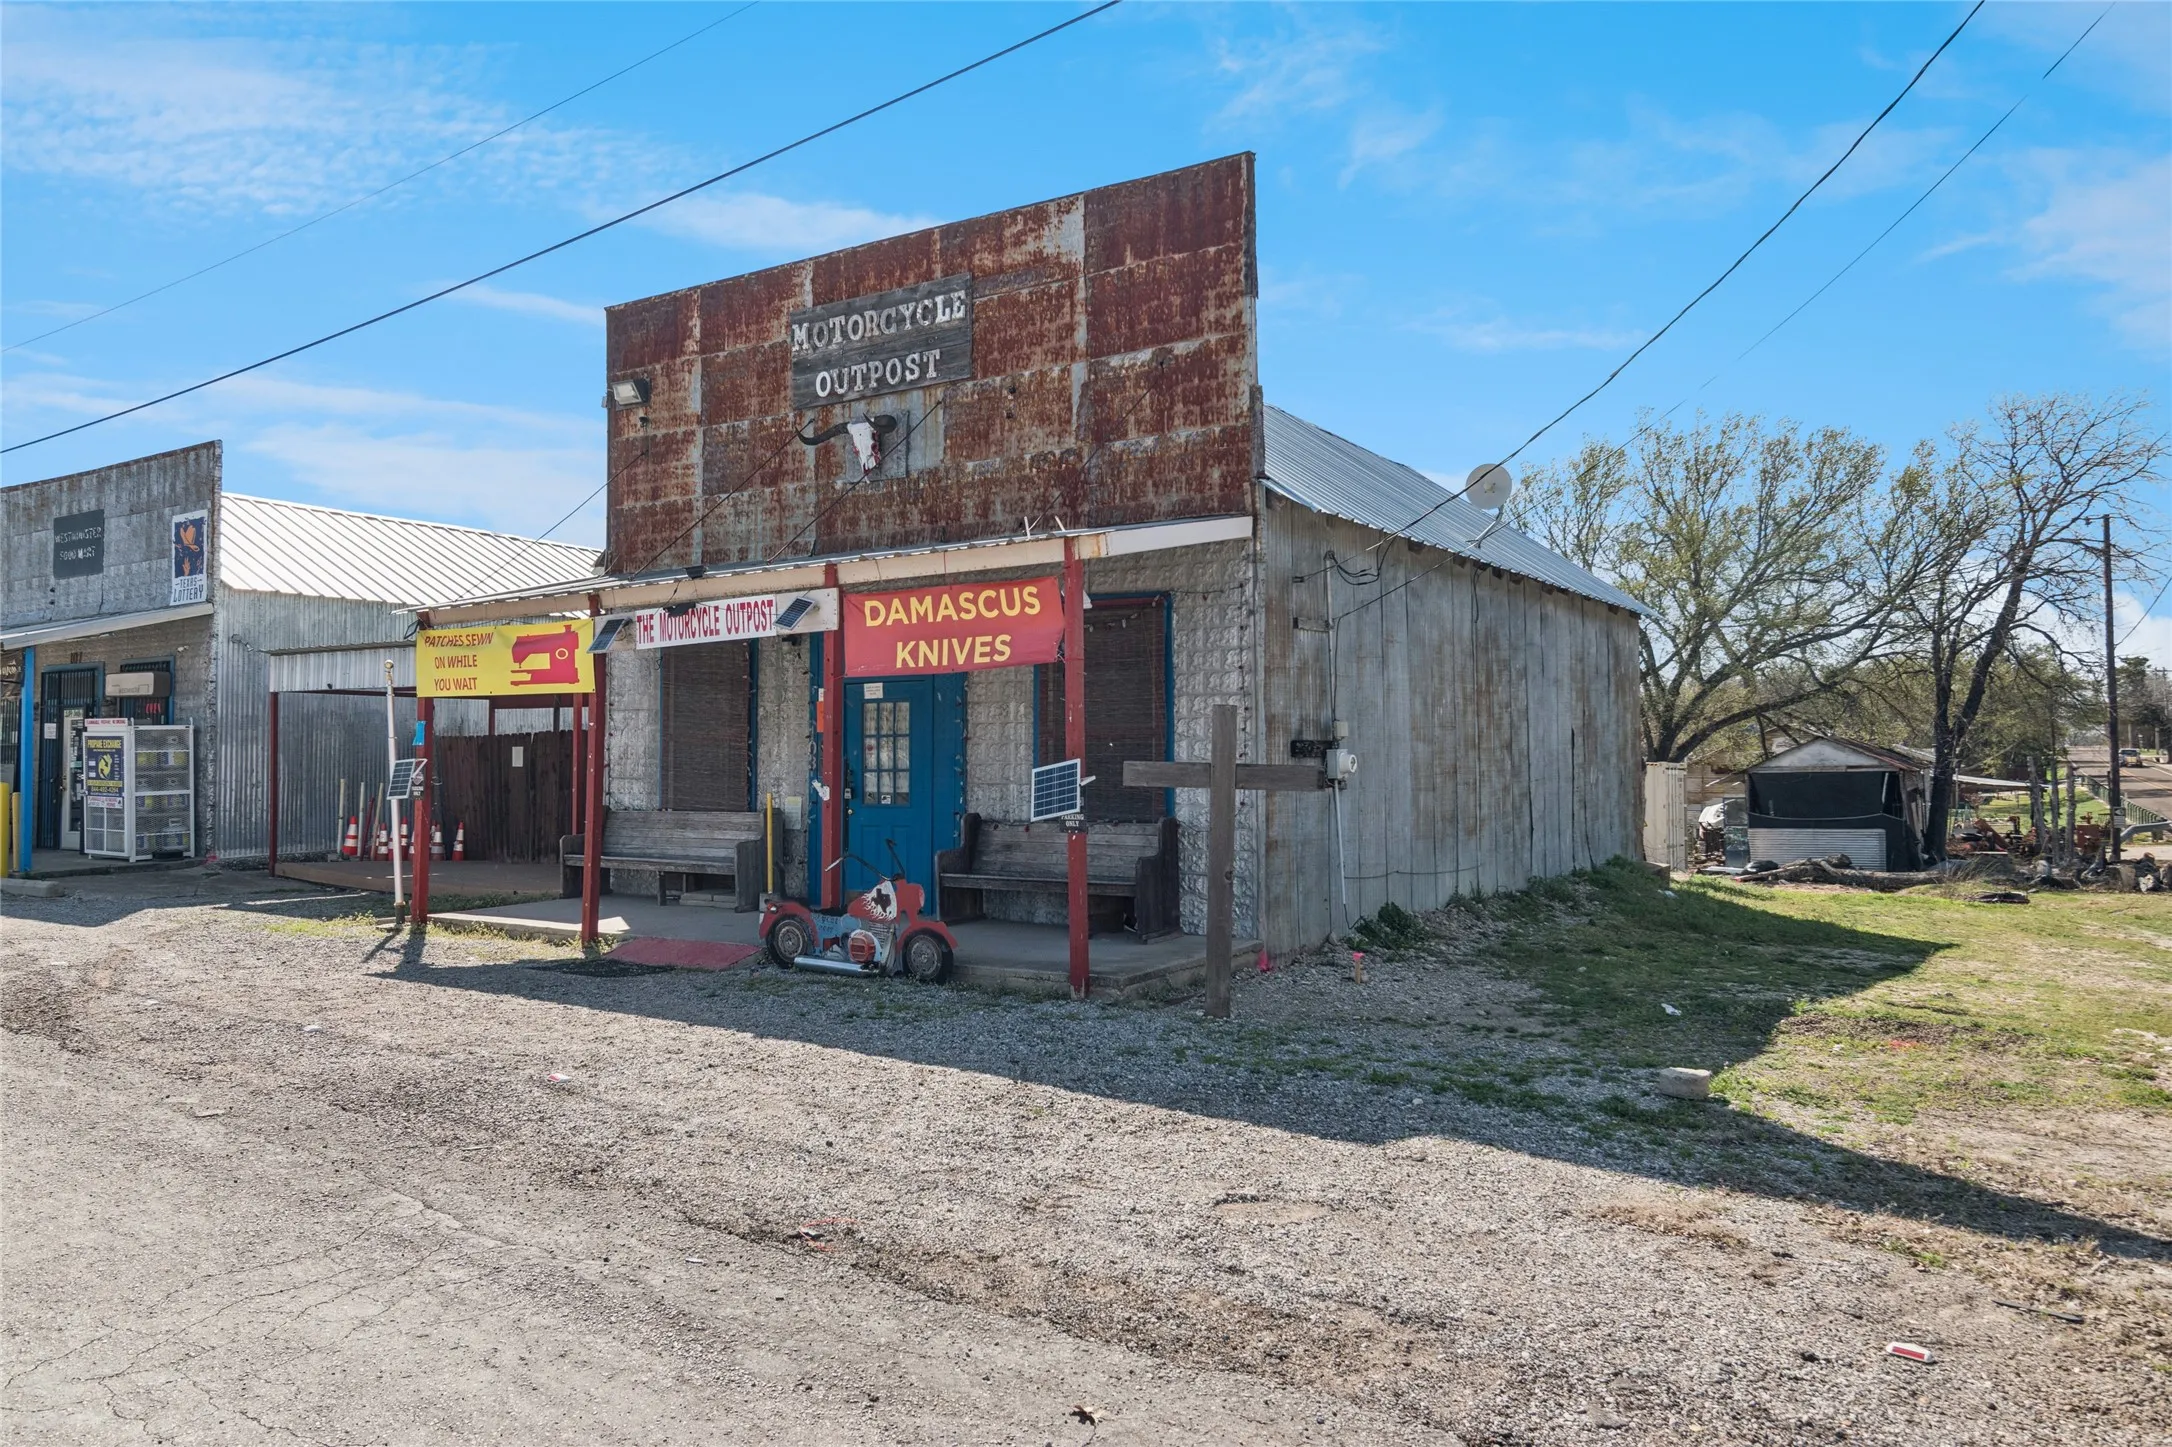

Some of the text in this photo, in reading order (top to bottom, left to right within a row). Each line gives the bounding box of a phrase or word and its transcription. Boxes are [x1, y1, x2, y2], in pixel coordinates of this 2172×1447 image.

[791, 290, 967, 352] MOTORCYCLE
[815, 349, 941, 398] OUTPOST
[180, 578, 197, 588] TEXAS
[173, 588, 203, 603] LOTTERY
[864, 586, 1041, 627] DAMASCUS
[636, 599, 774, 645] THE MOTORCYCLE OUTPOST
[424, 632, 494, 649] PATCHES SEWN
[896, 634, 1012, 669] KNIVES
[434, 655, 478, 670] ON WHILE
[434, 677, 478, 691] YOU WAIT
[87, 739, 121, 749] PROPANE EXCHANGE
